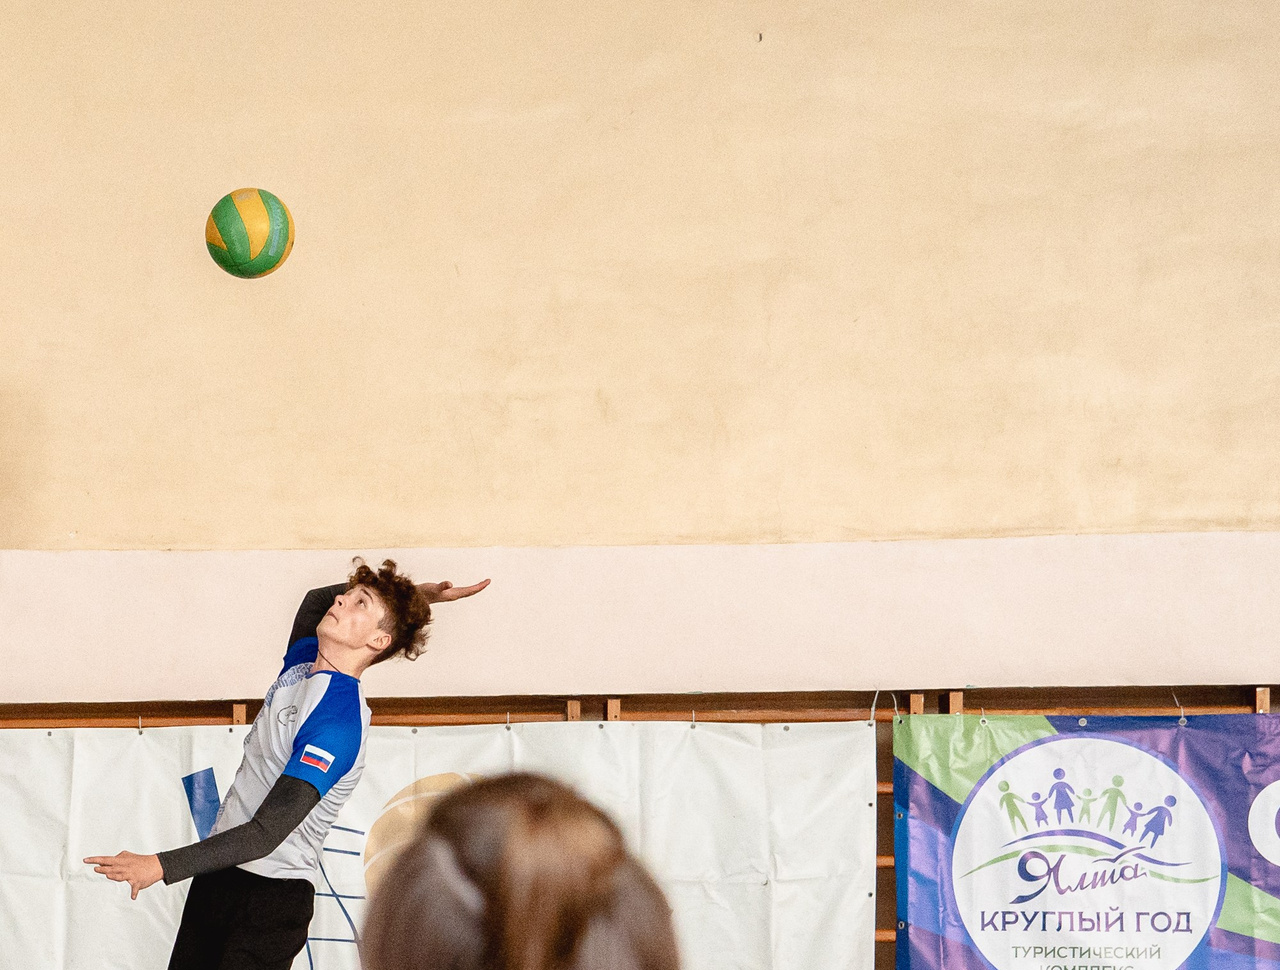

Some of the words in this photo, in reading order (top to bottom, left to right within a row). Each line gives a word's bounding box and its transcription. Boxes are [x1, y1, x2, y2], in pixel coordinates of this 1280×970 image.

[1009, 850, 1147, 905] Ялта
[980, 906, 1125, 932] КРУГЛЫЙ
[1135, 911, 1193, 934] ГОД
[1011, 944, 1162, 960] ТУРИСТИЧЕСКИЙ
